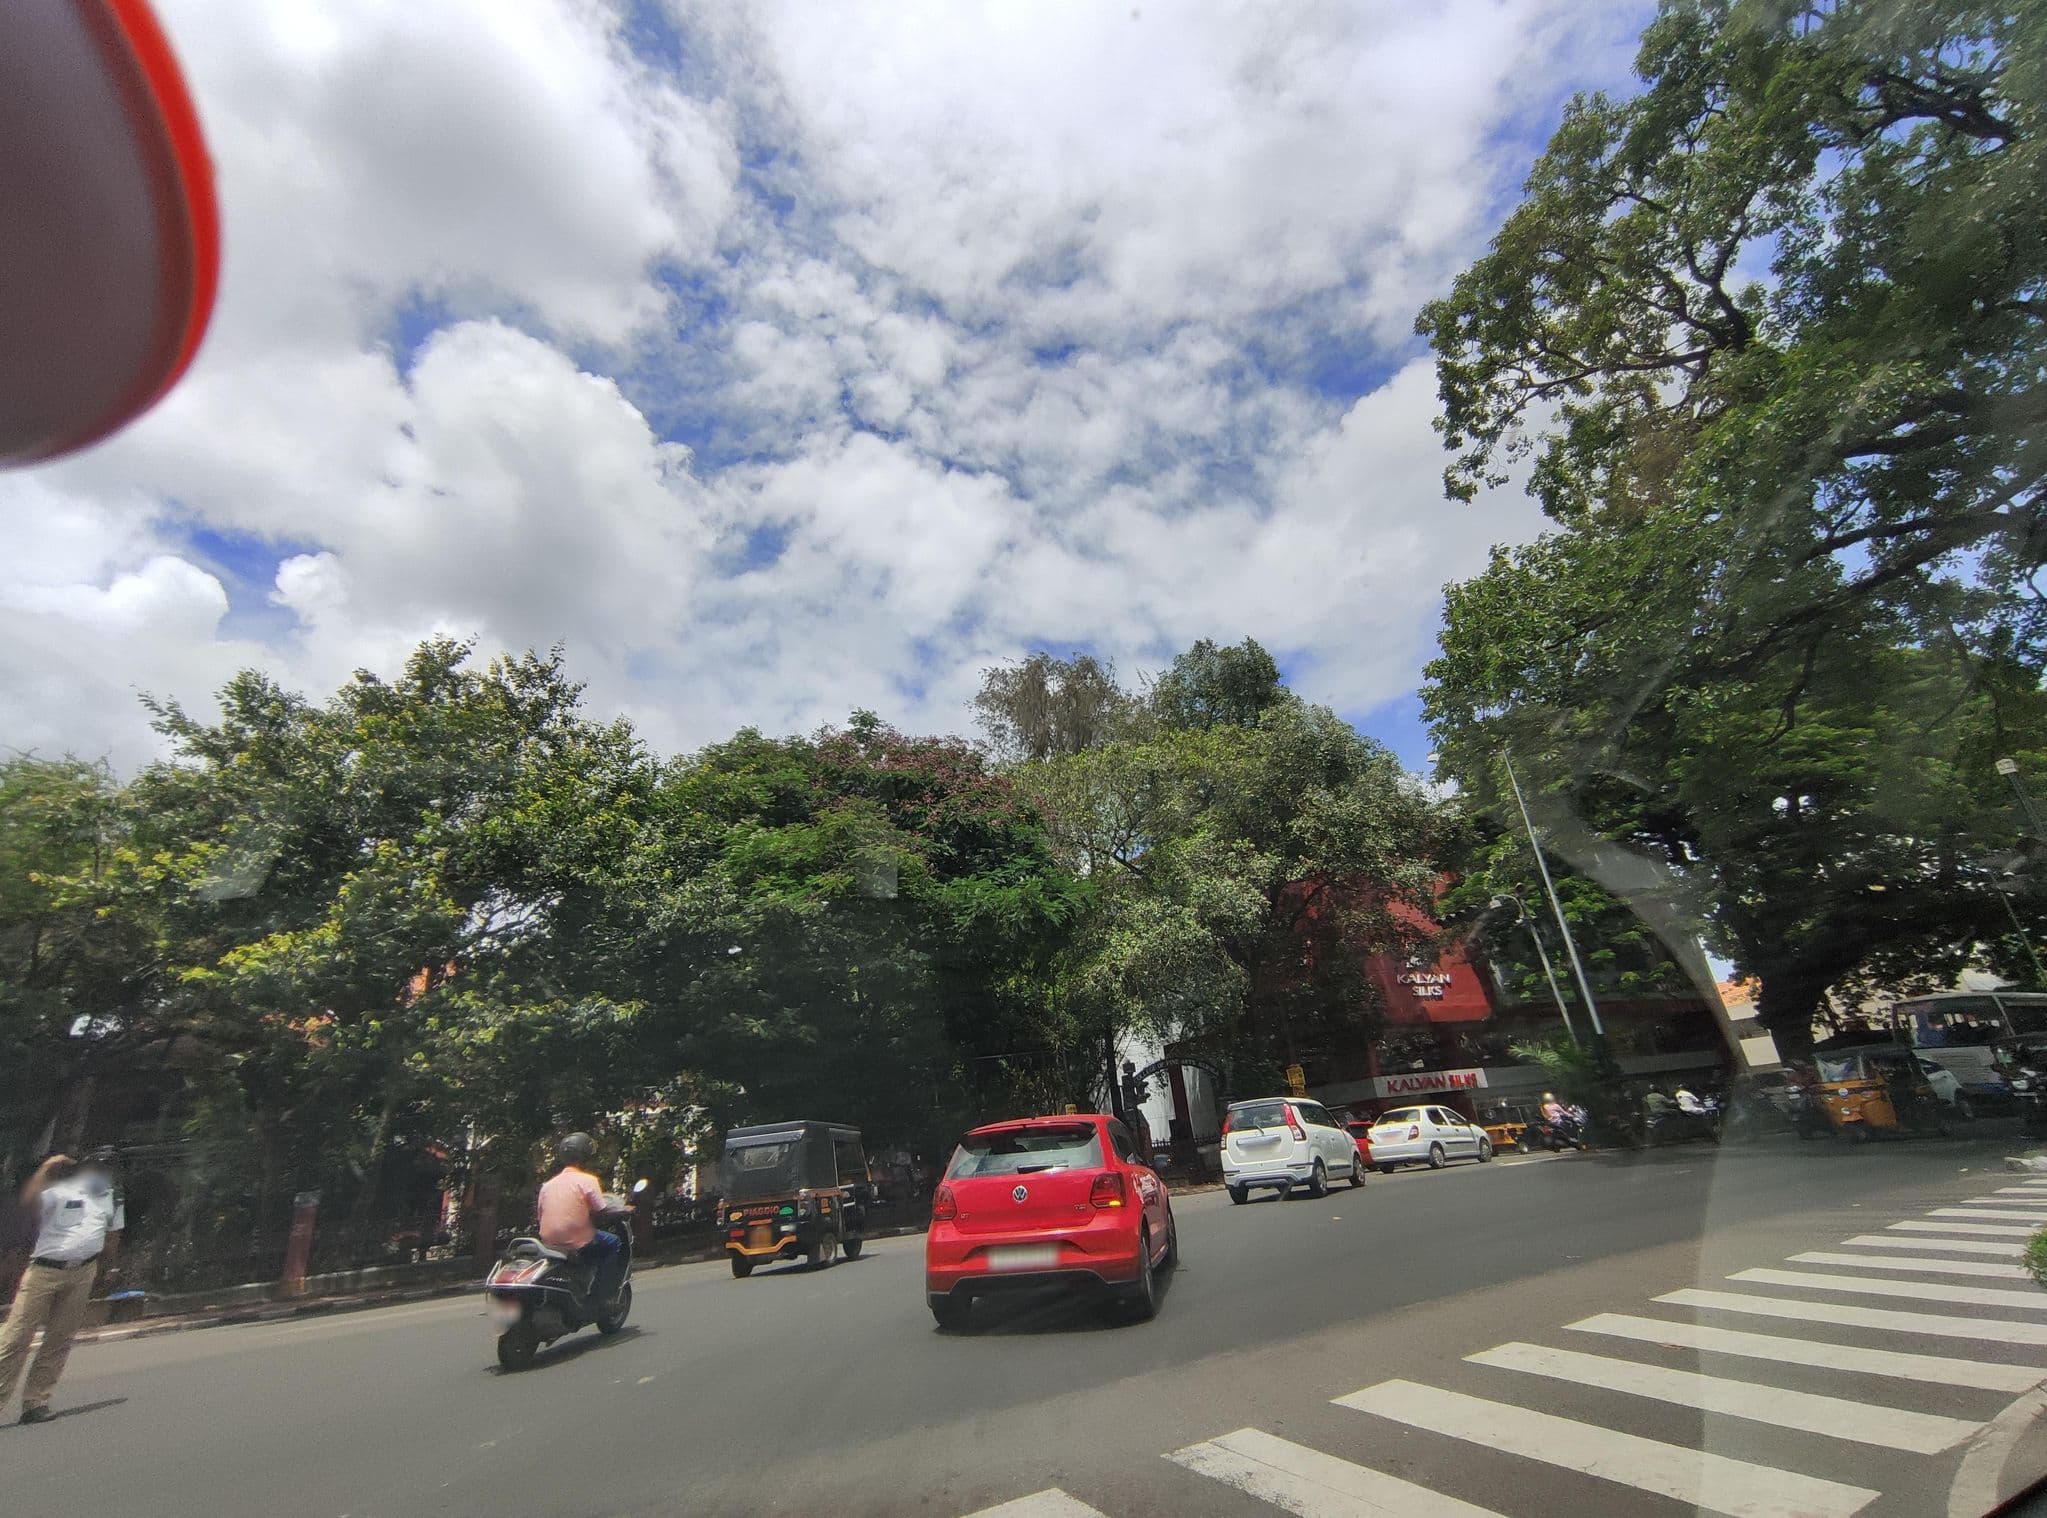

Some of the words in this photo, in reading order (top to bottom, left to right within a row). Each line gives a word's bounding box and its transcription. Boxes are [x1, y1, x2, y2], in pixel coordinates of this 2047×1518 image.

[1396, 973, 1451, 984] KALYAN
[1412, 985, 1443, 996] SILKS
[1386, 1075, 1446, 1095] KALYAN
